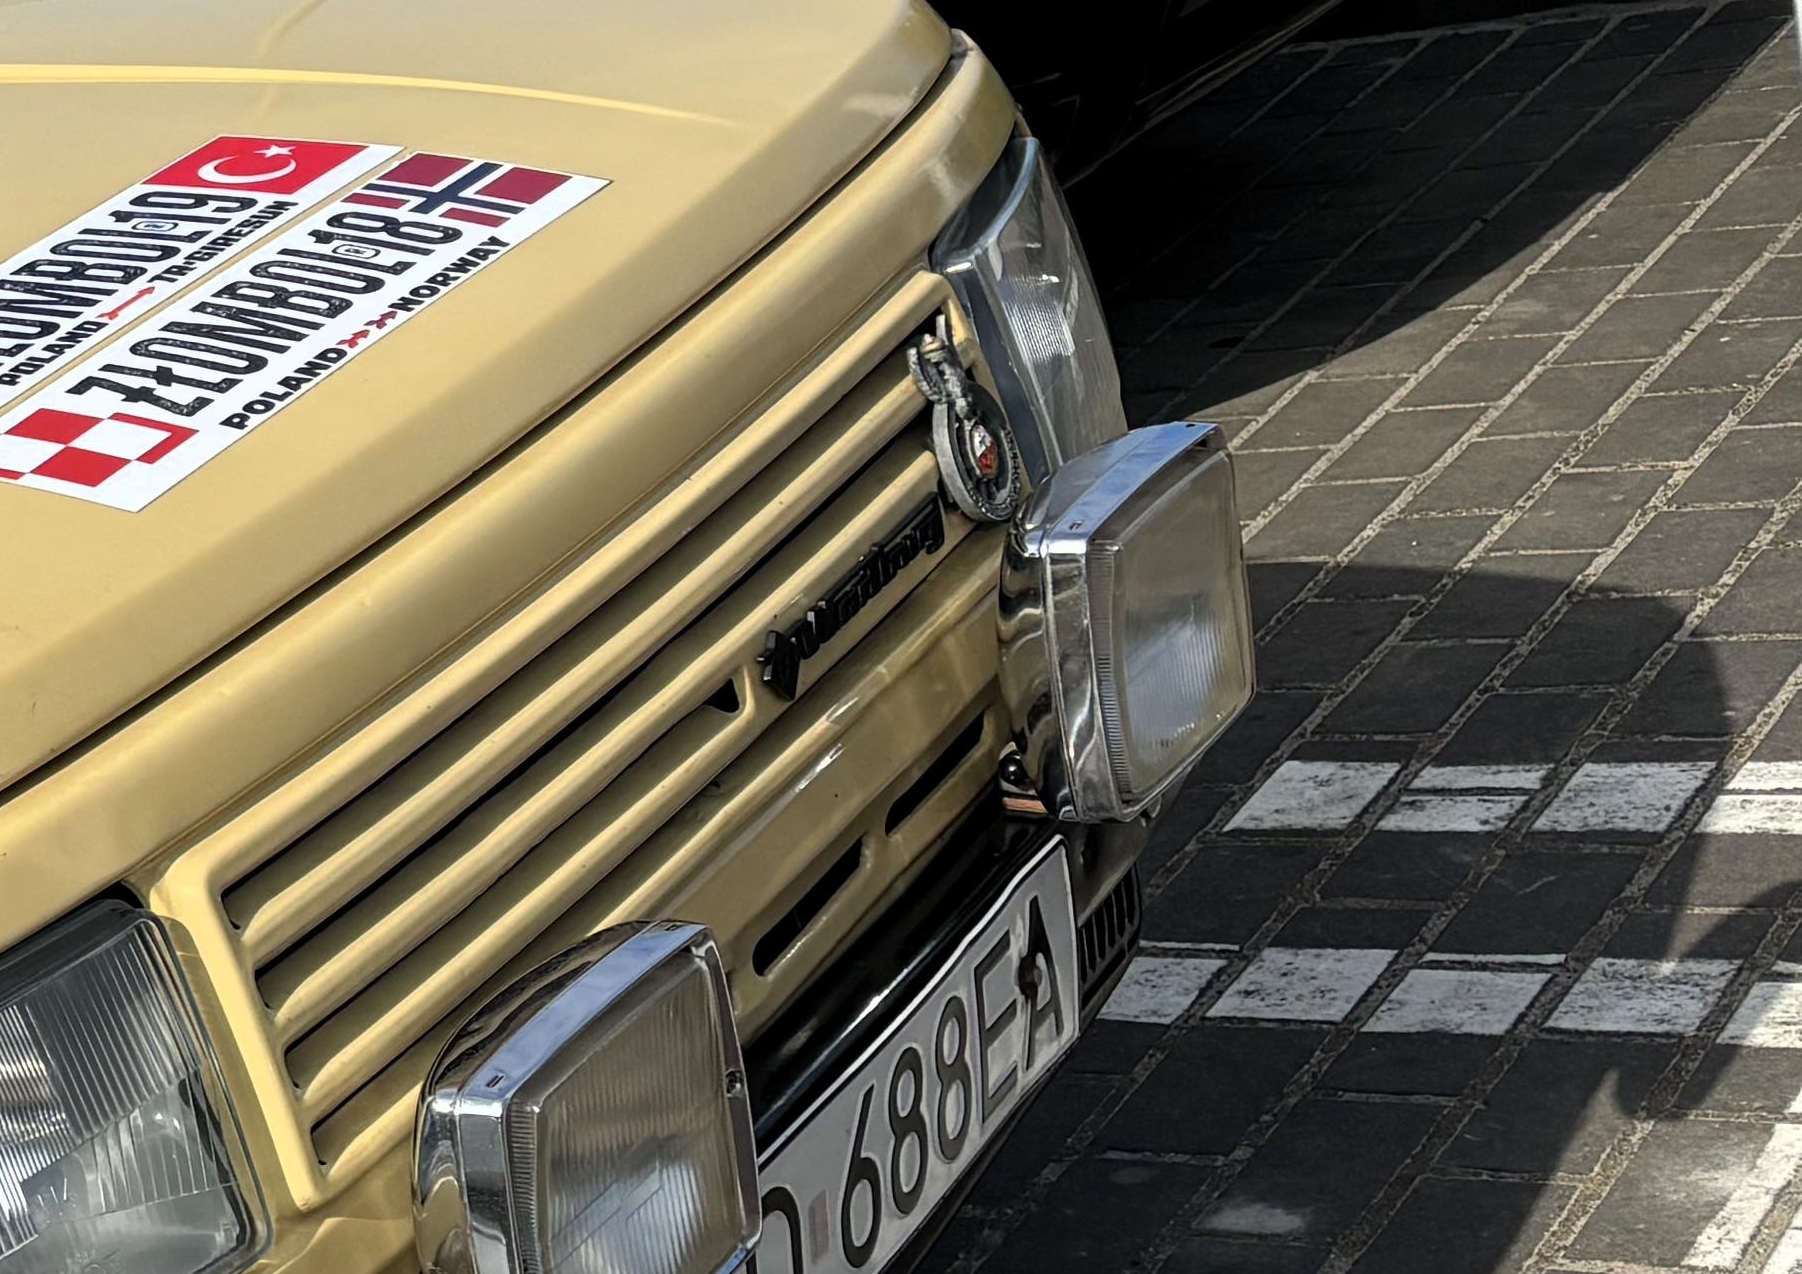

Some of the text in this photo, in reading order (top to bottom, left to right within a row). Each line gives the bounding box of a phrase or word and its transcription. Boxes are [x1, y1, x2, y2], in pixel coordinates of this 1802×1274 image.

[217, 235, 512, 431] POLAND NORWAY
[841, 897, 1064, 1269] 688EA
